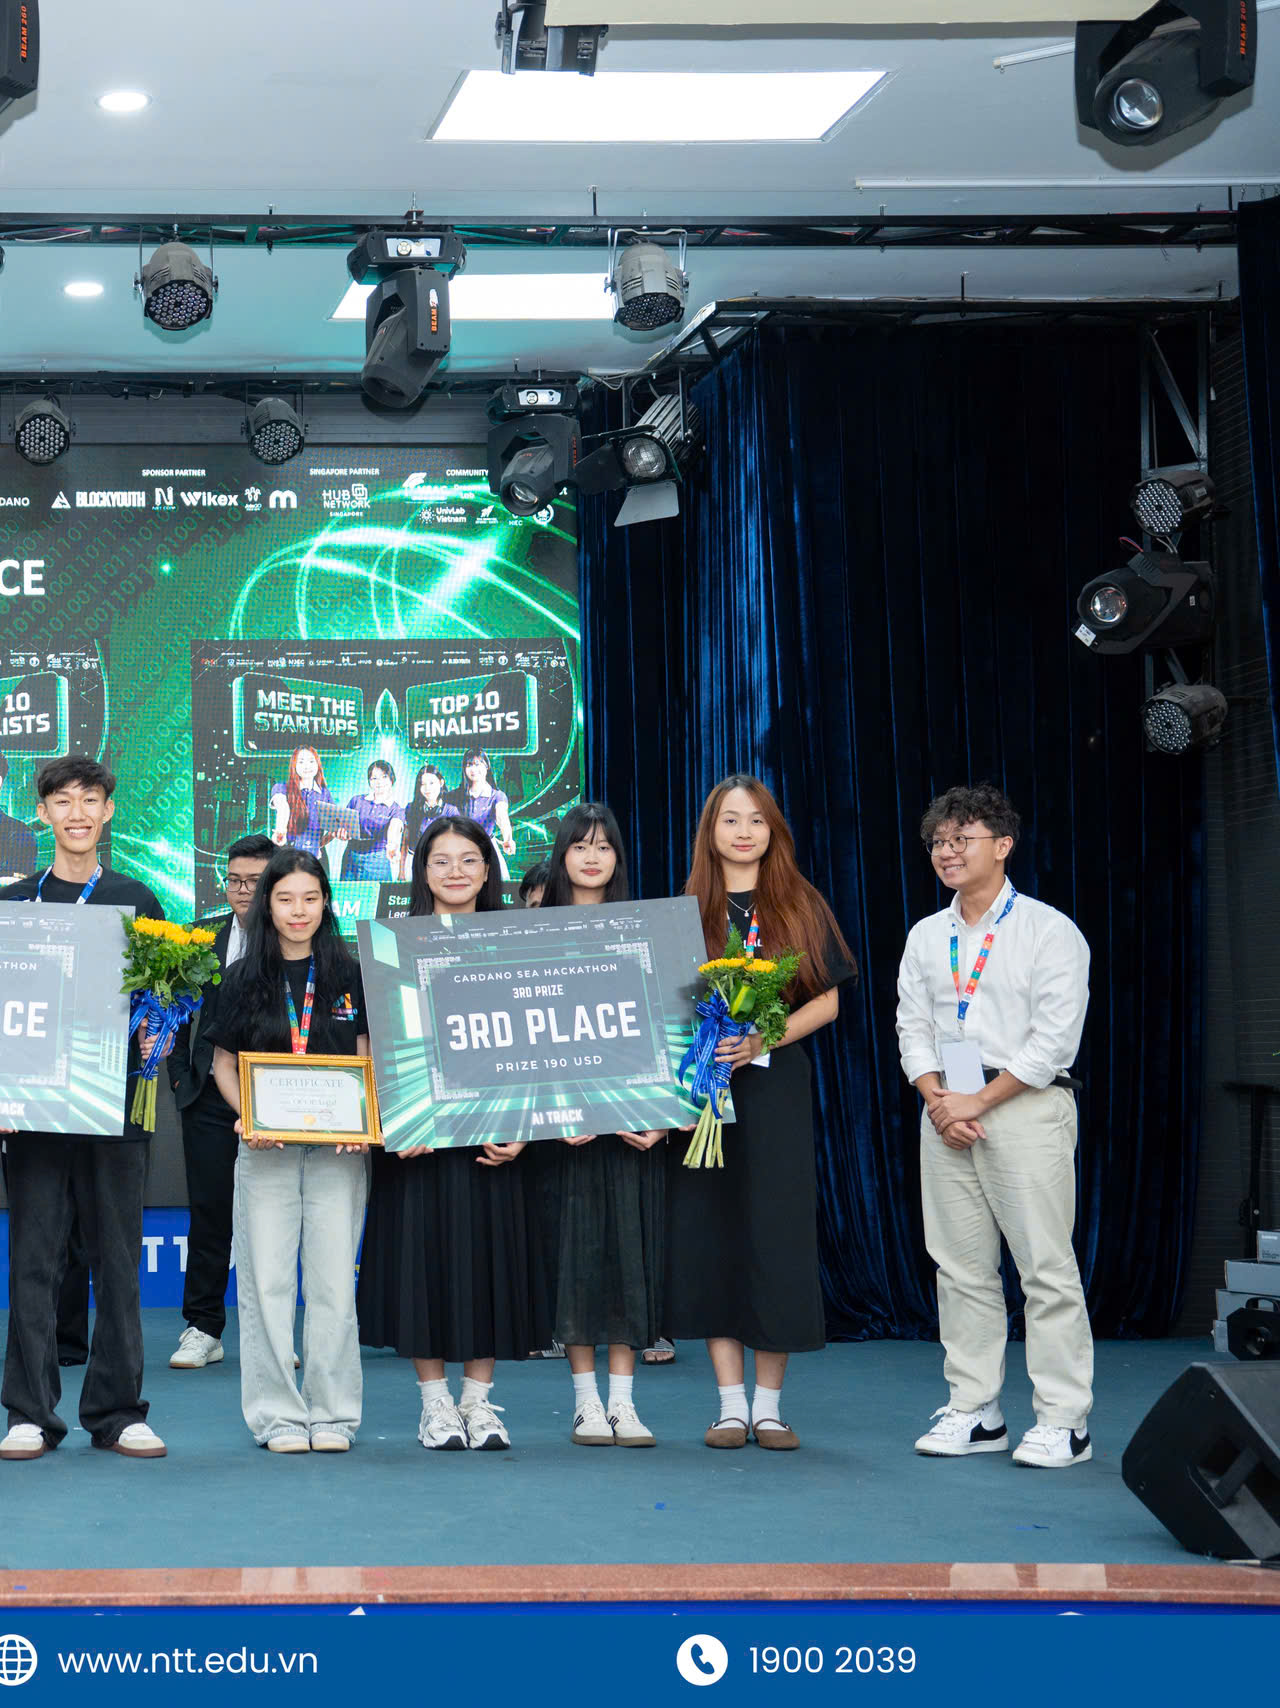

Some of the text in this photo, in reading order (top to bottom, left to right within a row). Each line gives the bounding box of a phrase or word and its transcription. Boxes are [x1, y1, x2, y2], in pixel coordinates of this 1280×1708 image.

[20, 27, 28, 58] BEAM
[75, 491, 146, 508] BLOCKYOUTH
[180, 491, 239, 506] Wikex
[322, 489, 351, 500] HUB
[323, 500, 371, 508] NETWORK
[436, 515, 467, 523] Vietnam
[4, 692, 30, 713] 10
[257, 689, 356, 718] MEET THE
[429, 690, 499, 715] TOP 10
[253, 711, 359, 738] STARTUPS
[413, 711, 520, 739] FINALISTS
[454, 962, 618, 983] CARDANO SEA HACKATHON
[512, 983, 564, 999] 3RD PRIZE
[446, 1000, 641, 1051] 3RD PLACE
[495, 1054, 603, 1073] PRIZE 190 USD
[269, 1077, 345, 1089] CERTIFICATE
[531, 1108, 584, 1126] AI TRACK
